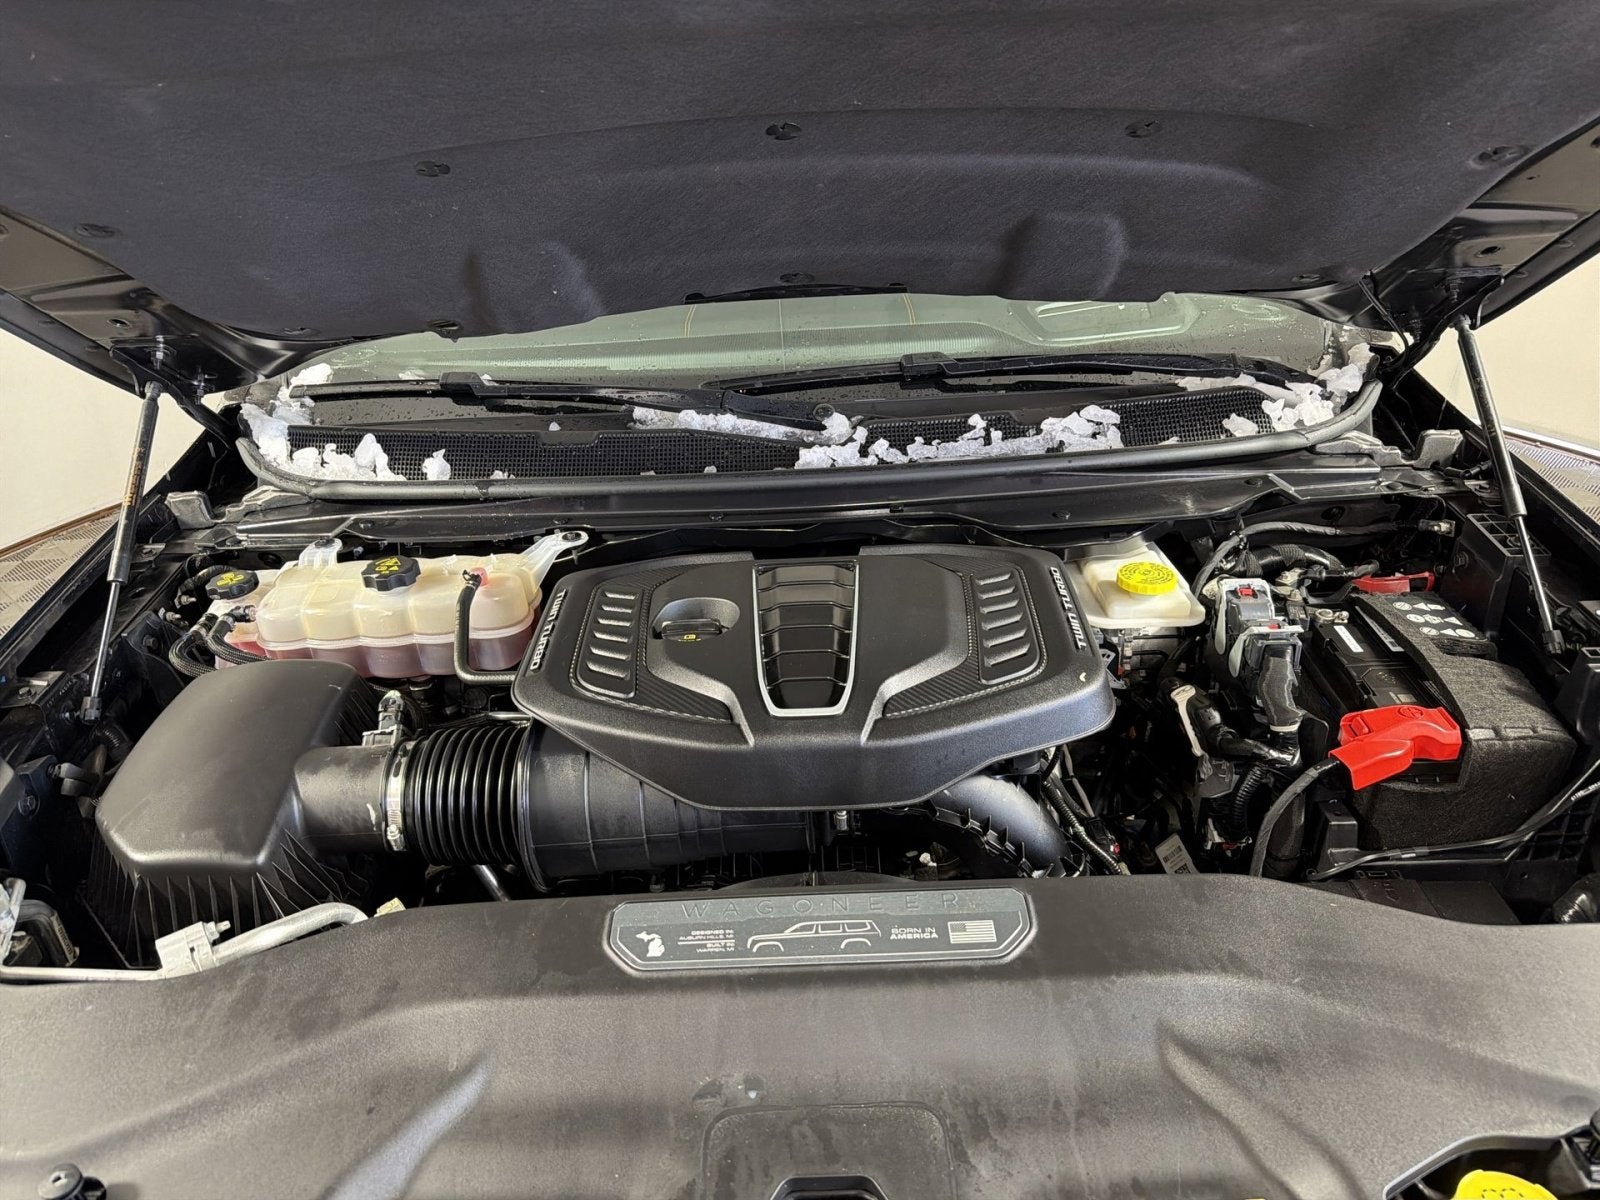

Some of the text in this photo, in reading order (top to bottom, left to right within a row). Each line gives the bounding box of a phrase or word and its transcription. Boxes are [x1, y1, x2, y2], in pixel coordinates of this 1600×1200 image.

[529, 589, 567, 670] TWIN TURBO
[1050, 566, 1087, 649] TWIN TURBO
[681, 892, 959, 919] WAGONEER
[890, 932, 939, 940] AMERICA
